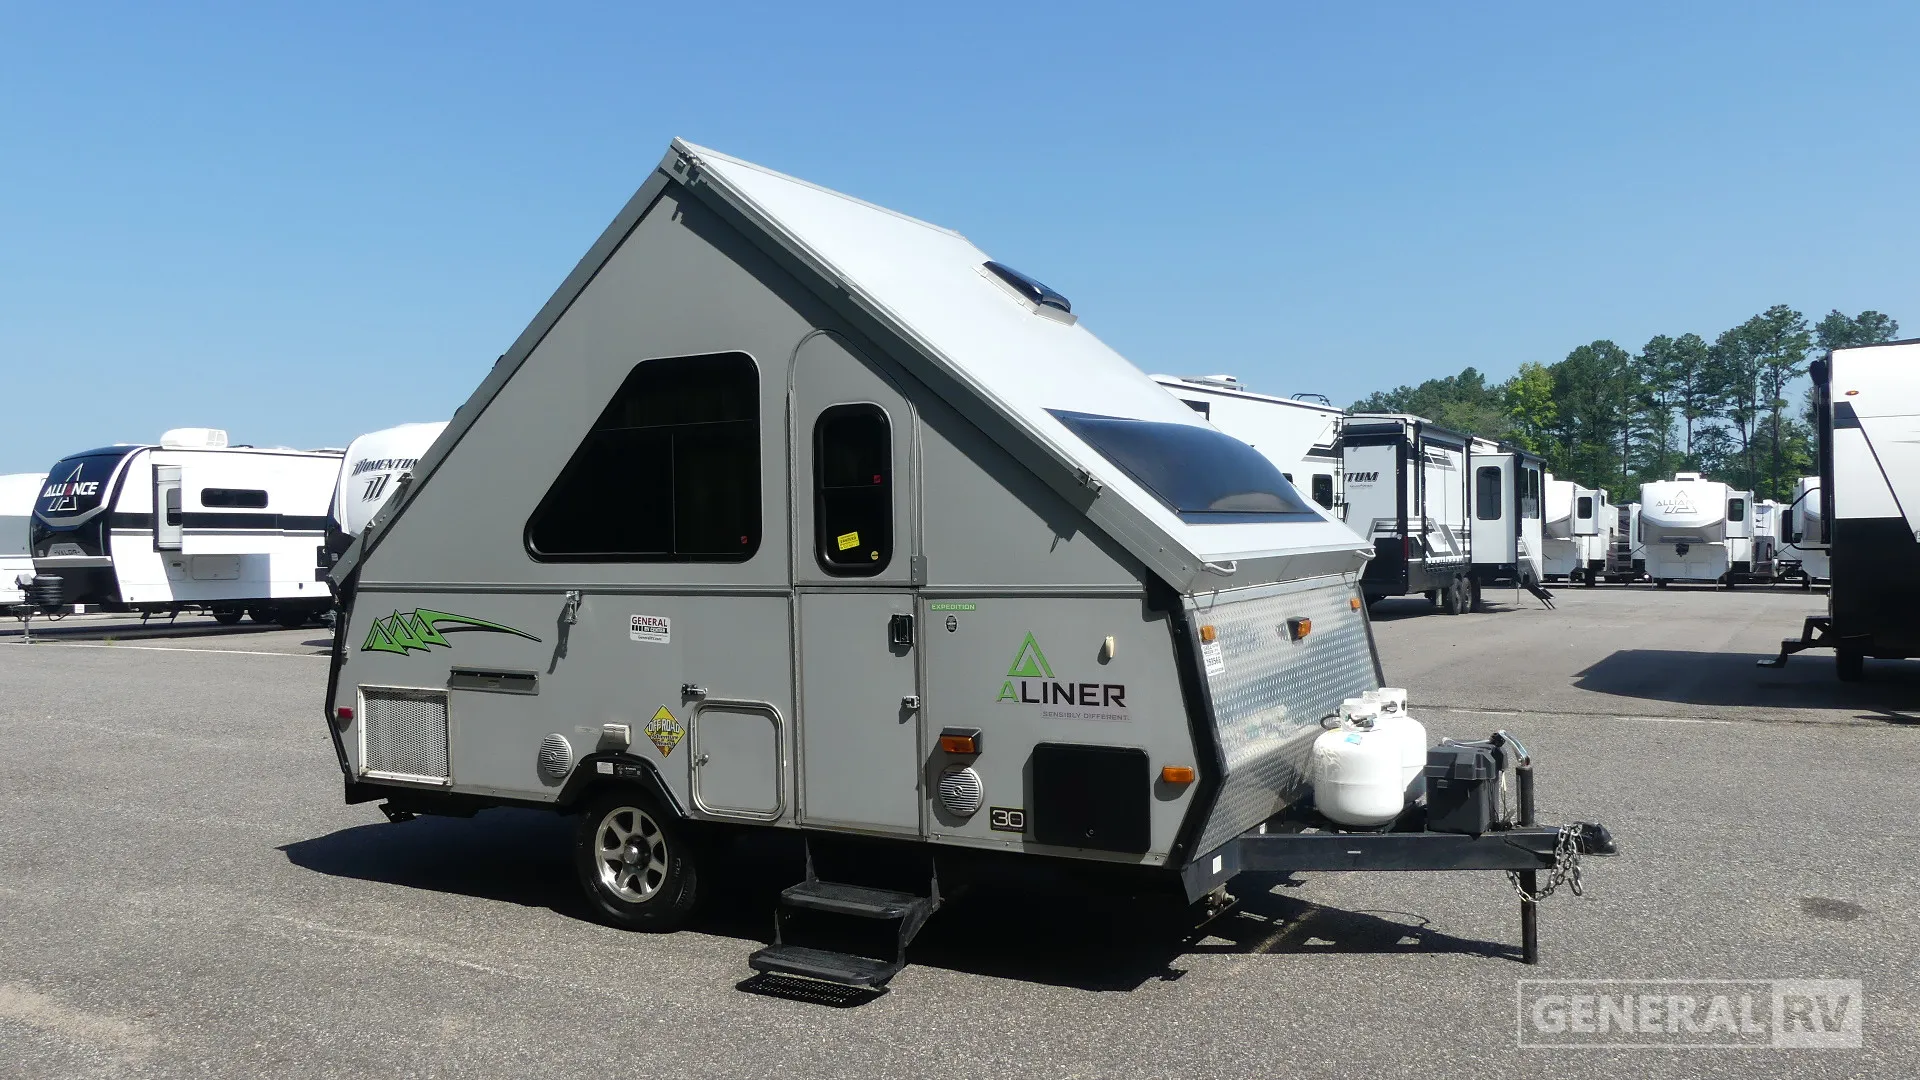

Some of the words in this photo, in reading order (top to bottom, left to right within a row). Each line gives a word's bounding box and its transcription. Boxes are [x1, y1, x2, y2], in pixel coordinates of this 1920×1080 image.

[43, 481, 99, 498] ALLIANCE
[631, 616, 668, 627] GENERAL
[996, 680, 1127, 708] ALINER
[1043, 711, 1081, 719] SENSIBLY
[648, 719, 661, 732] OFF
[661, 718, 681, 733] ROAD
[992, 809, 1024, 828] 30
